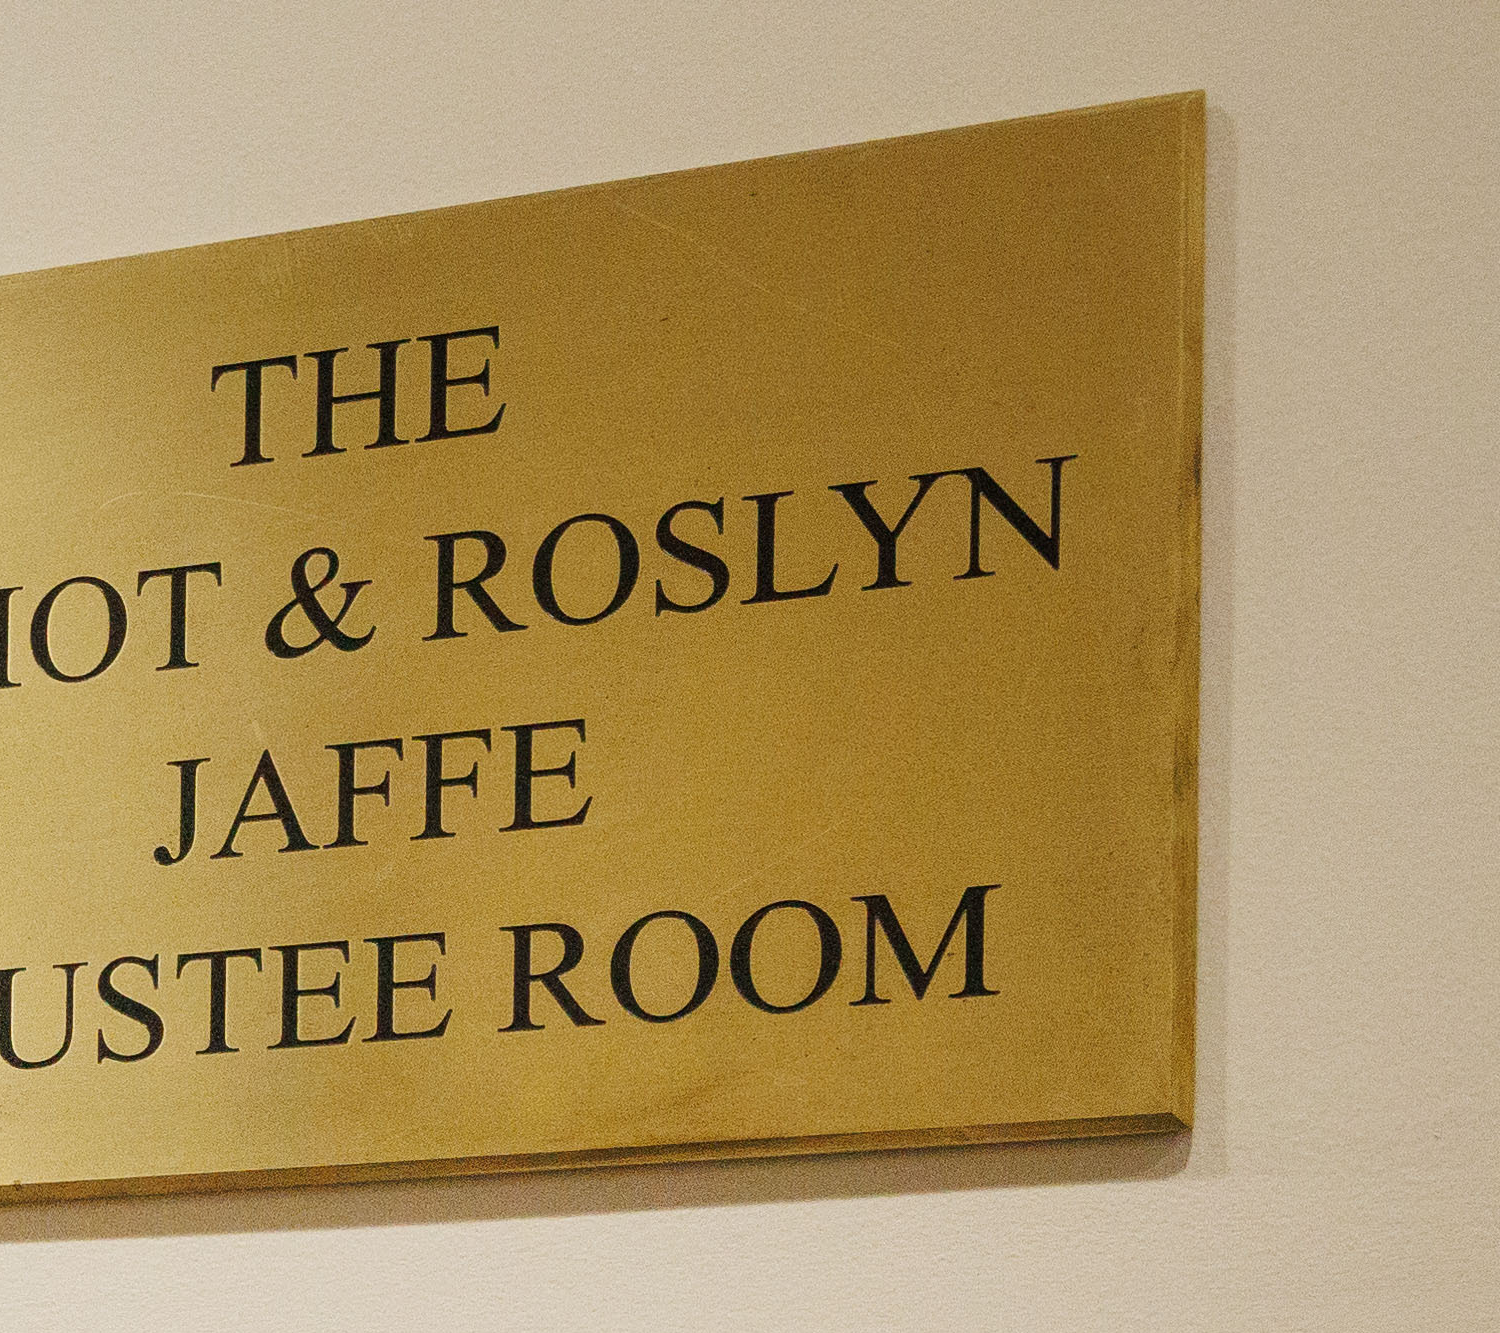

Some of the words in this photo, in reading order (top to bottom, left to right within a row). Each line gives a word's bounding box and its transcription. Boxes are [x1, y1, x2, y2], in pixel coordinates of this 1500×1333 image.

[211, 326, 506, 467] THE
[265, 547, 376, 658] &
[422, 455, 1078, 641] ROSLYN
[154, 719, 592, 866] JAFFE
[498, 884, 1001, 1032] ROOM
